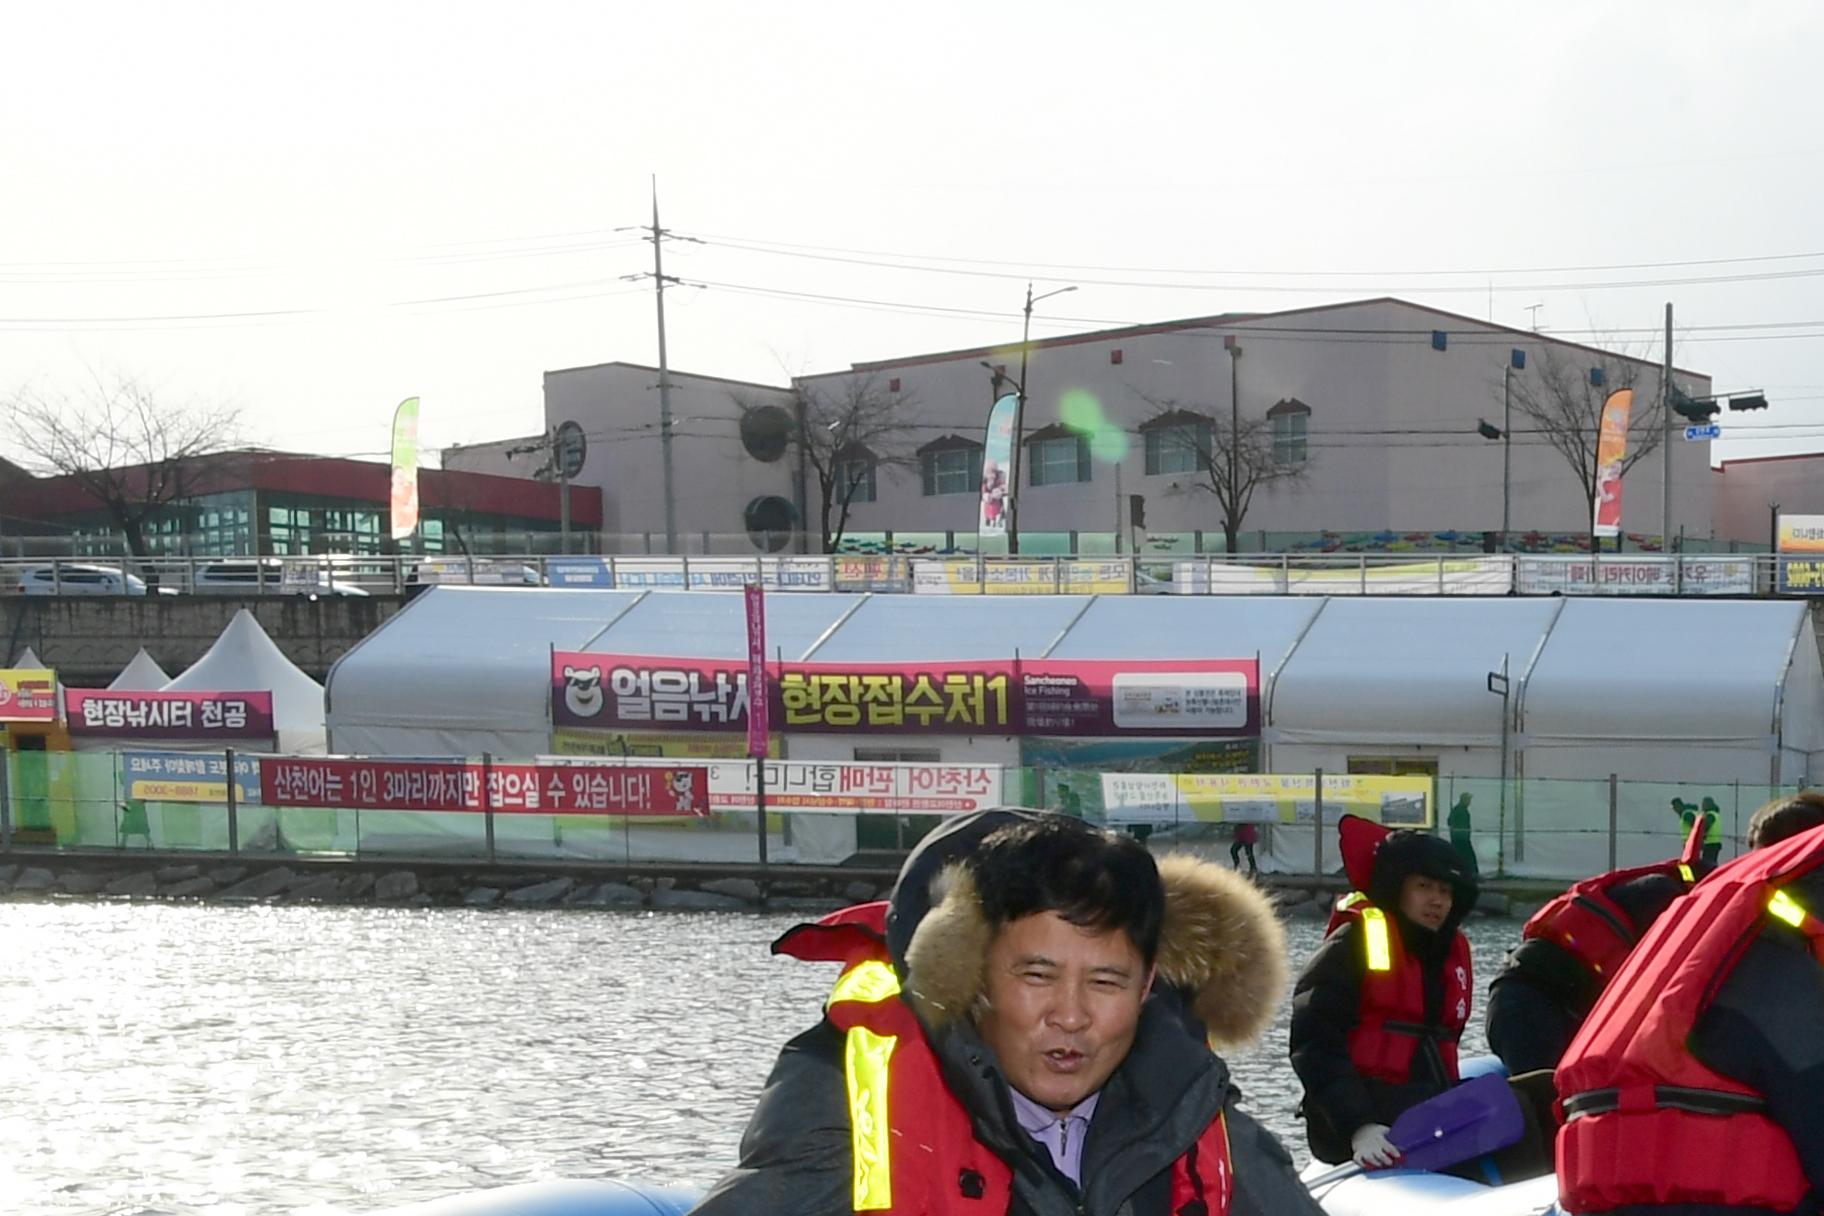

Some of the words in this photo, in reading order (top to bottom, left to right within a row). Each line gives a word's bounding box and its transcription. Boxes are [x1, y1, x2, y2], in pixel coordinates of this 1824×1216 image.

[781, 673, 1008, 726] 현장접수처1
[1038, 687, 1071, 698] Fishing
[83, 699, 192, 728] 현장낚시터
[274, 765, 343, 802] 산천어는
[351, 769, 376, 803] 1인
[384, 768, 480, 807] 3마리까지만
[487, 770, 540, 809] 잡으실
[547, 772, 565, 808] 수
[572, 772, 651, 809] 있습니다!
